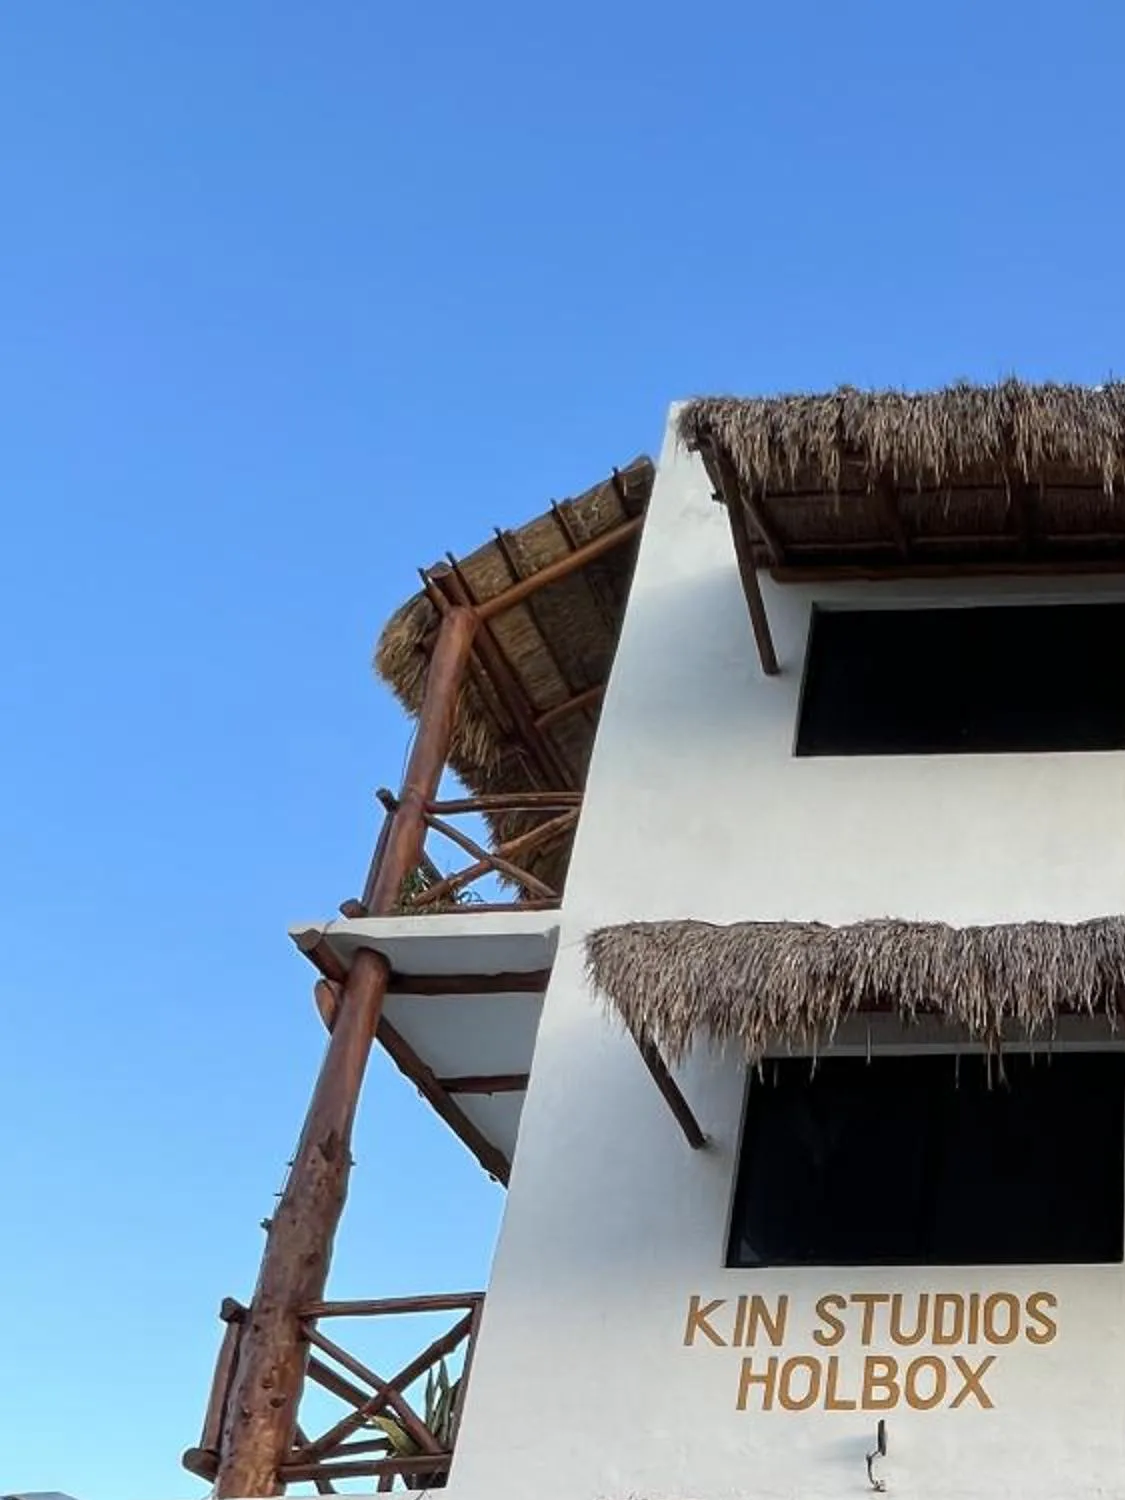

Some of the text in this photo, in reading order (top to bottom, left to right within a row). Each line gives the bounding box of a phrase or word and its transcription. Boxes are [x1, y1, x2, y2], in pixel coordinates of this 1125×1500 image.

[683, 1292, 1058, 1347] KIN STUDIOS
[735, 1355, 998, 1412] HOLBOX
